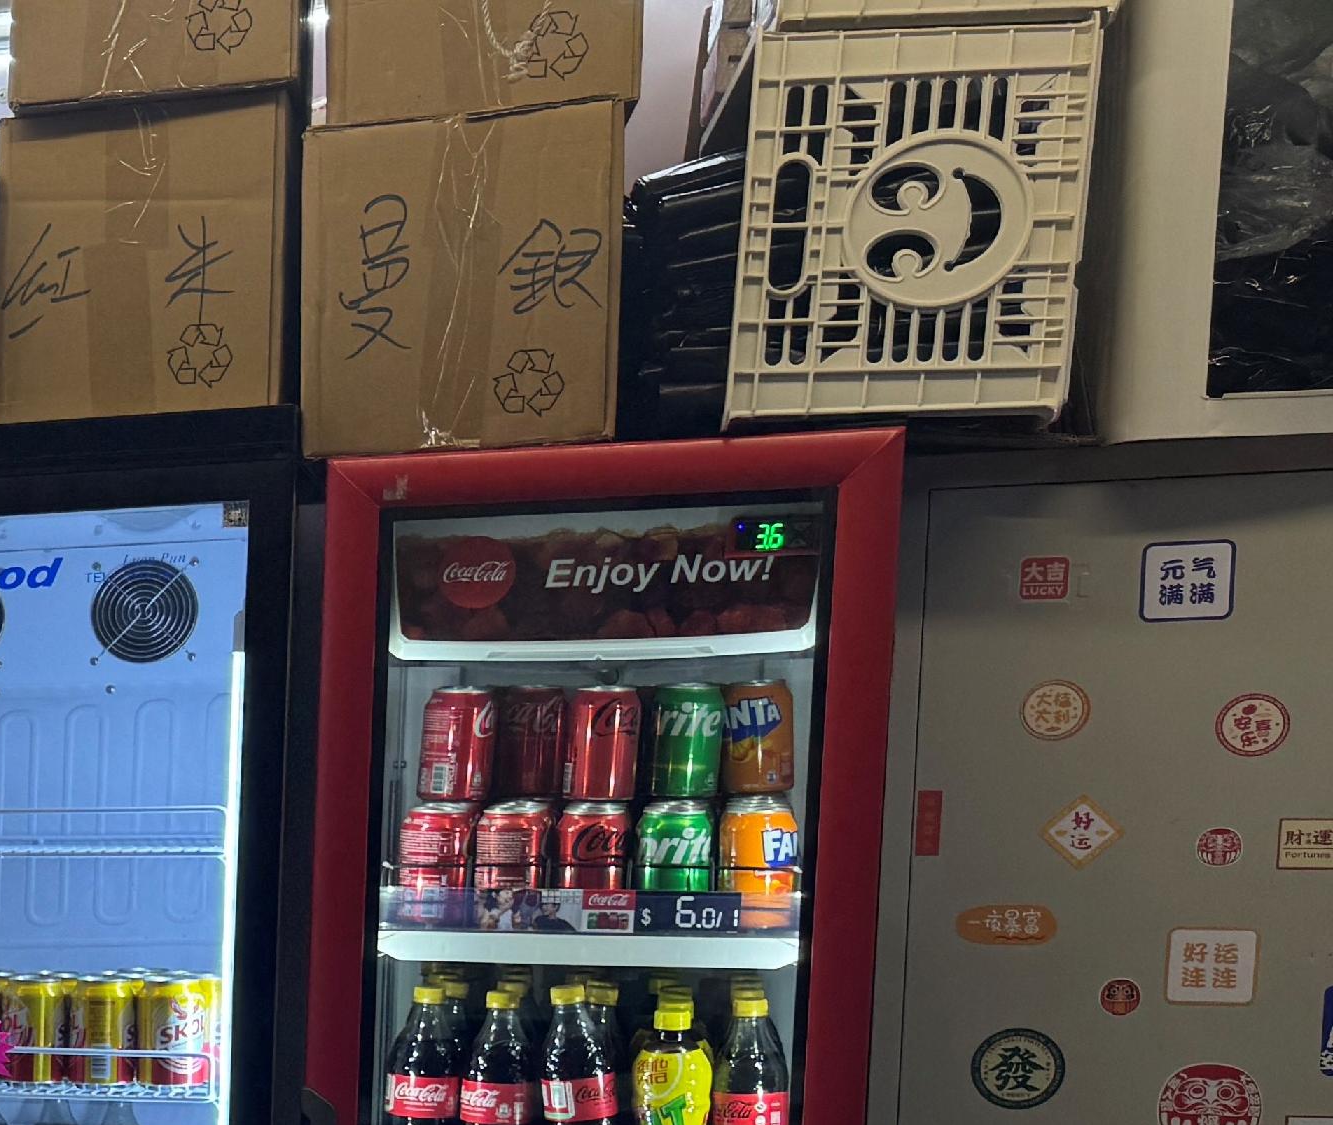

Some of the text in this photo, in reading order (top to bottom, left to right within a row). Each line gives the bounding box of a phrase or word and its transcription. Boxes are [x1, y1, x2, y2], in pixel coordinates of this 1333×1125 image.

[443, 560, 511, 584] Coca-Cola
[545, 554, 775, 595] Enjoy Now!
[1023, 561, 1066, 582] 大吉
[1160, 557, 1216, 581] 元气
[1022, 585, 1064, 597] LUCKY
[1159, 583, 1215, 606] 满满
[1069, 811, 1094, 851] 好运
[967, 909, 1042, 936] 一夜暴富
[1182, 943, 1239, 965] 好运
[990, 1046, 1045, 1092] 發
[394, 1081, 447, 1104] Coca-Cola
